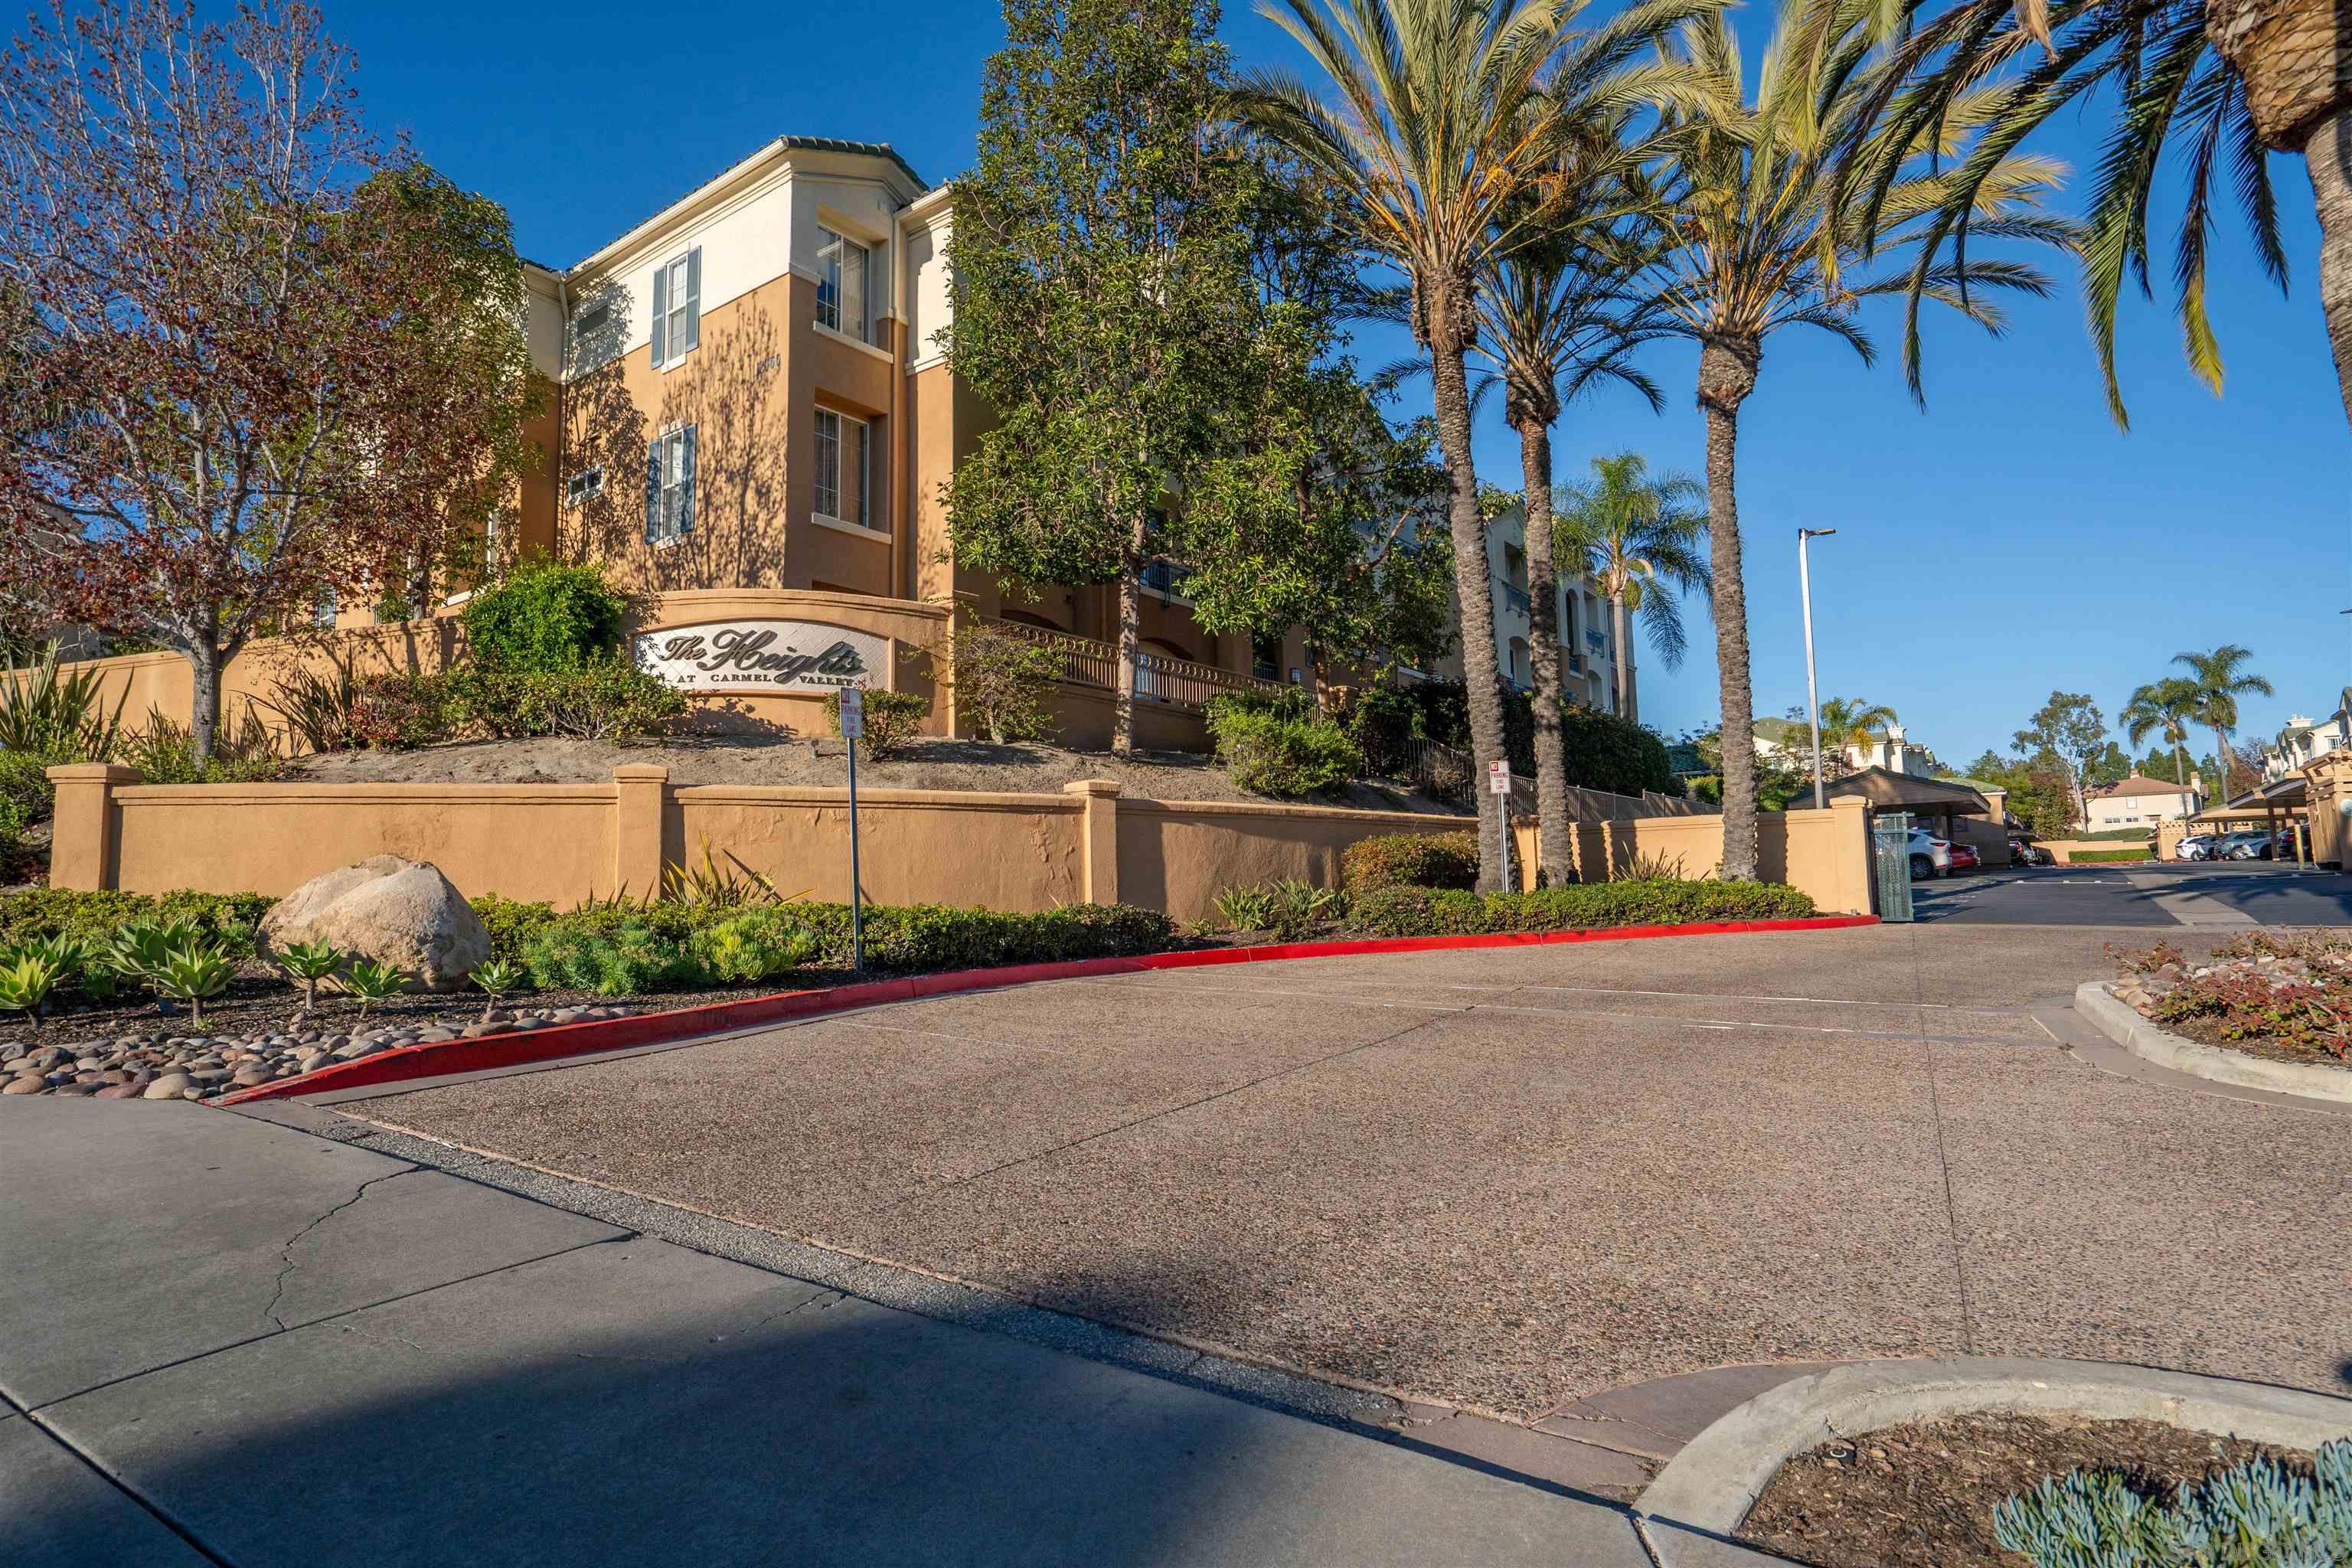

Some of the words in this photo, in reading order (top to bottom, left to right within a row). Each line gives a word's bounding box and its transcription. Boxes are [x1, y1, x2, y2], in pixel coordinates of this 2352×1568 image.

[658, 635, 707, 661] The
[696, 629, 864, 684] Heights
[677, 675, 696, 683] AT
[710, 674, 773, 682] CARMEL
[799, 675, 855, 687] VALLEY
[842, 704, 860, 715] PARKING
